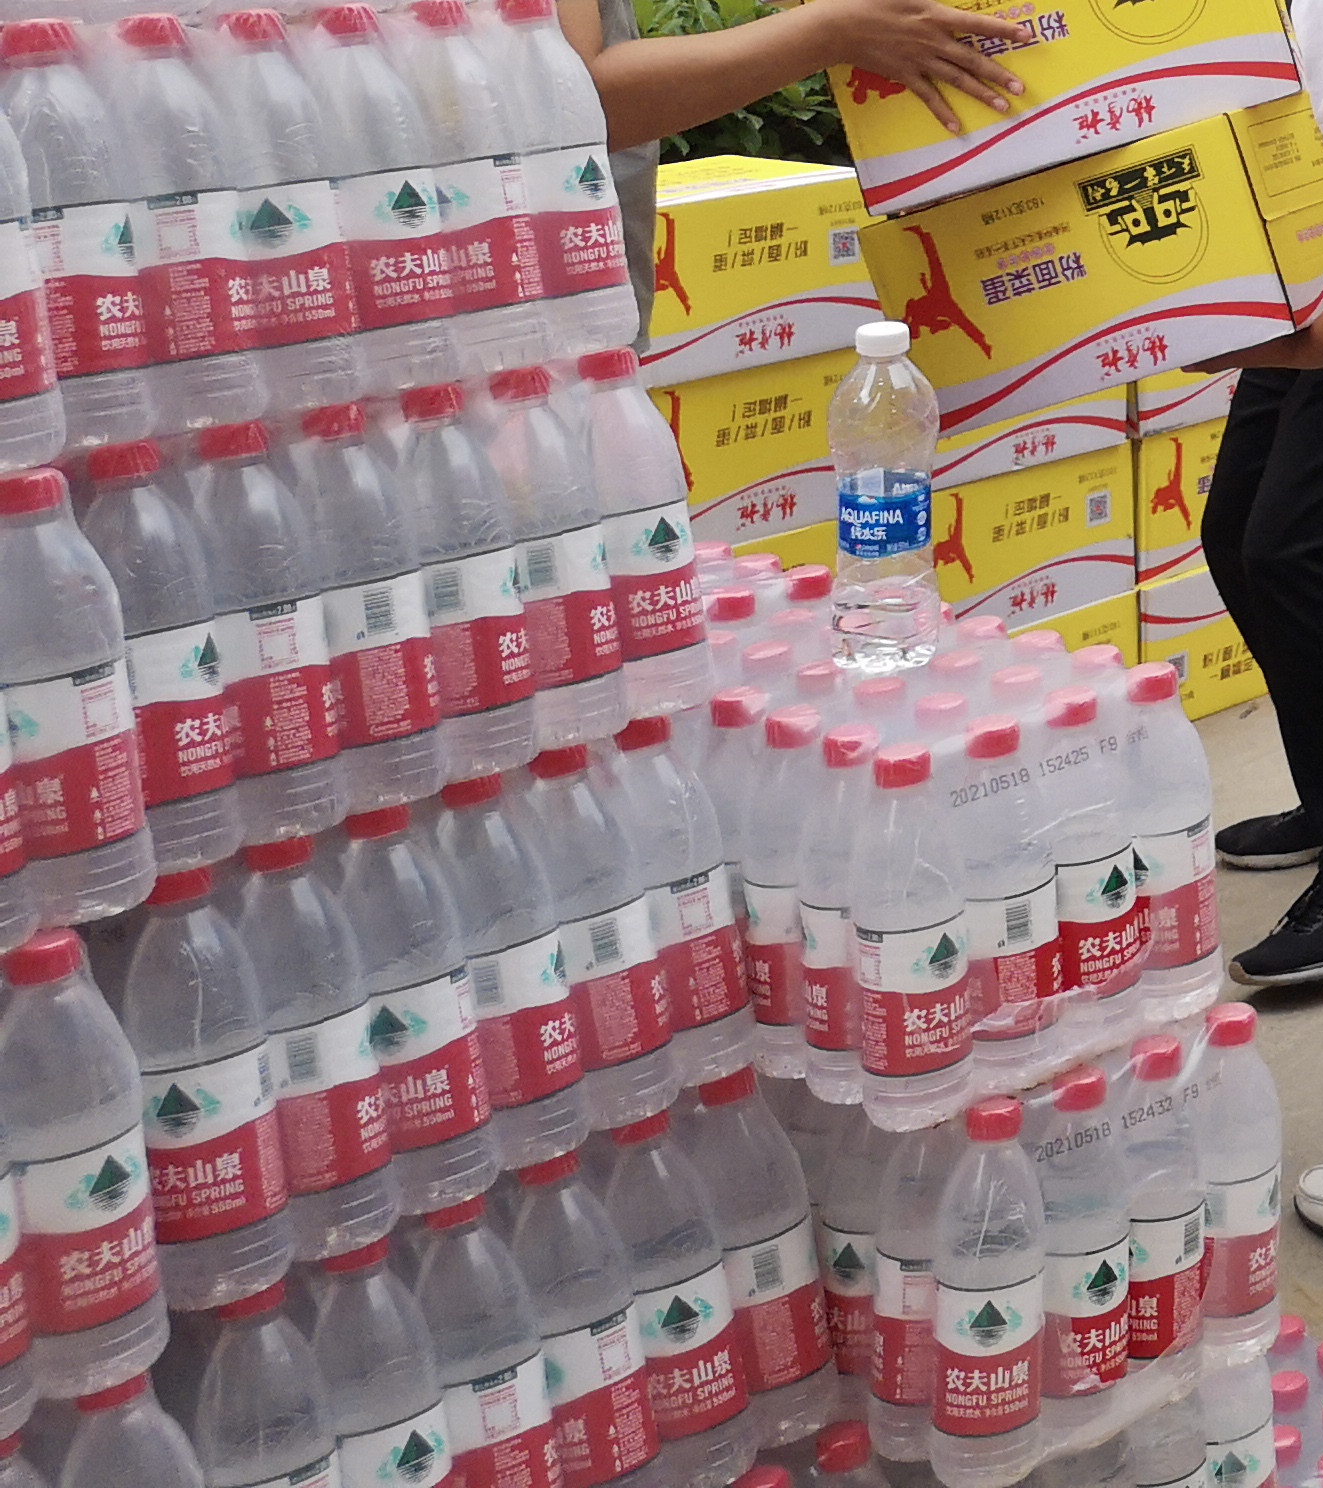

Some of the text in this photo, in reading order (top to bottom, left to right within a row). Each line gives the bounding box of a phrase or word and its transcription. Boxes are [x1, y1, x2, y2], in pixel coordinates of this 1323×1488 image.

[981, 252, 1088, 306] 粉面菜蛋
[841, 506, 904, 527] AQUAFINA
[951, 767, 1030, 808] 20210518
[1039, 746, 1090, 777] 152425
[1080, 953, 1122, 974] NONGFU
[904, 1026, 950, 1046] NONGFU
[1034, 1120, 1112, 1163] 20210518
[1121, 1096, 1173, 1130] 152432
[191, 1179, 245, 1205] SPRING
[945, 1360, 1031, 1392] 农夫山泉
[945, 1383, 1030, 1407] NONGFU SPRING
